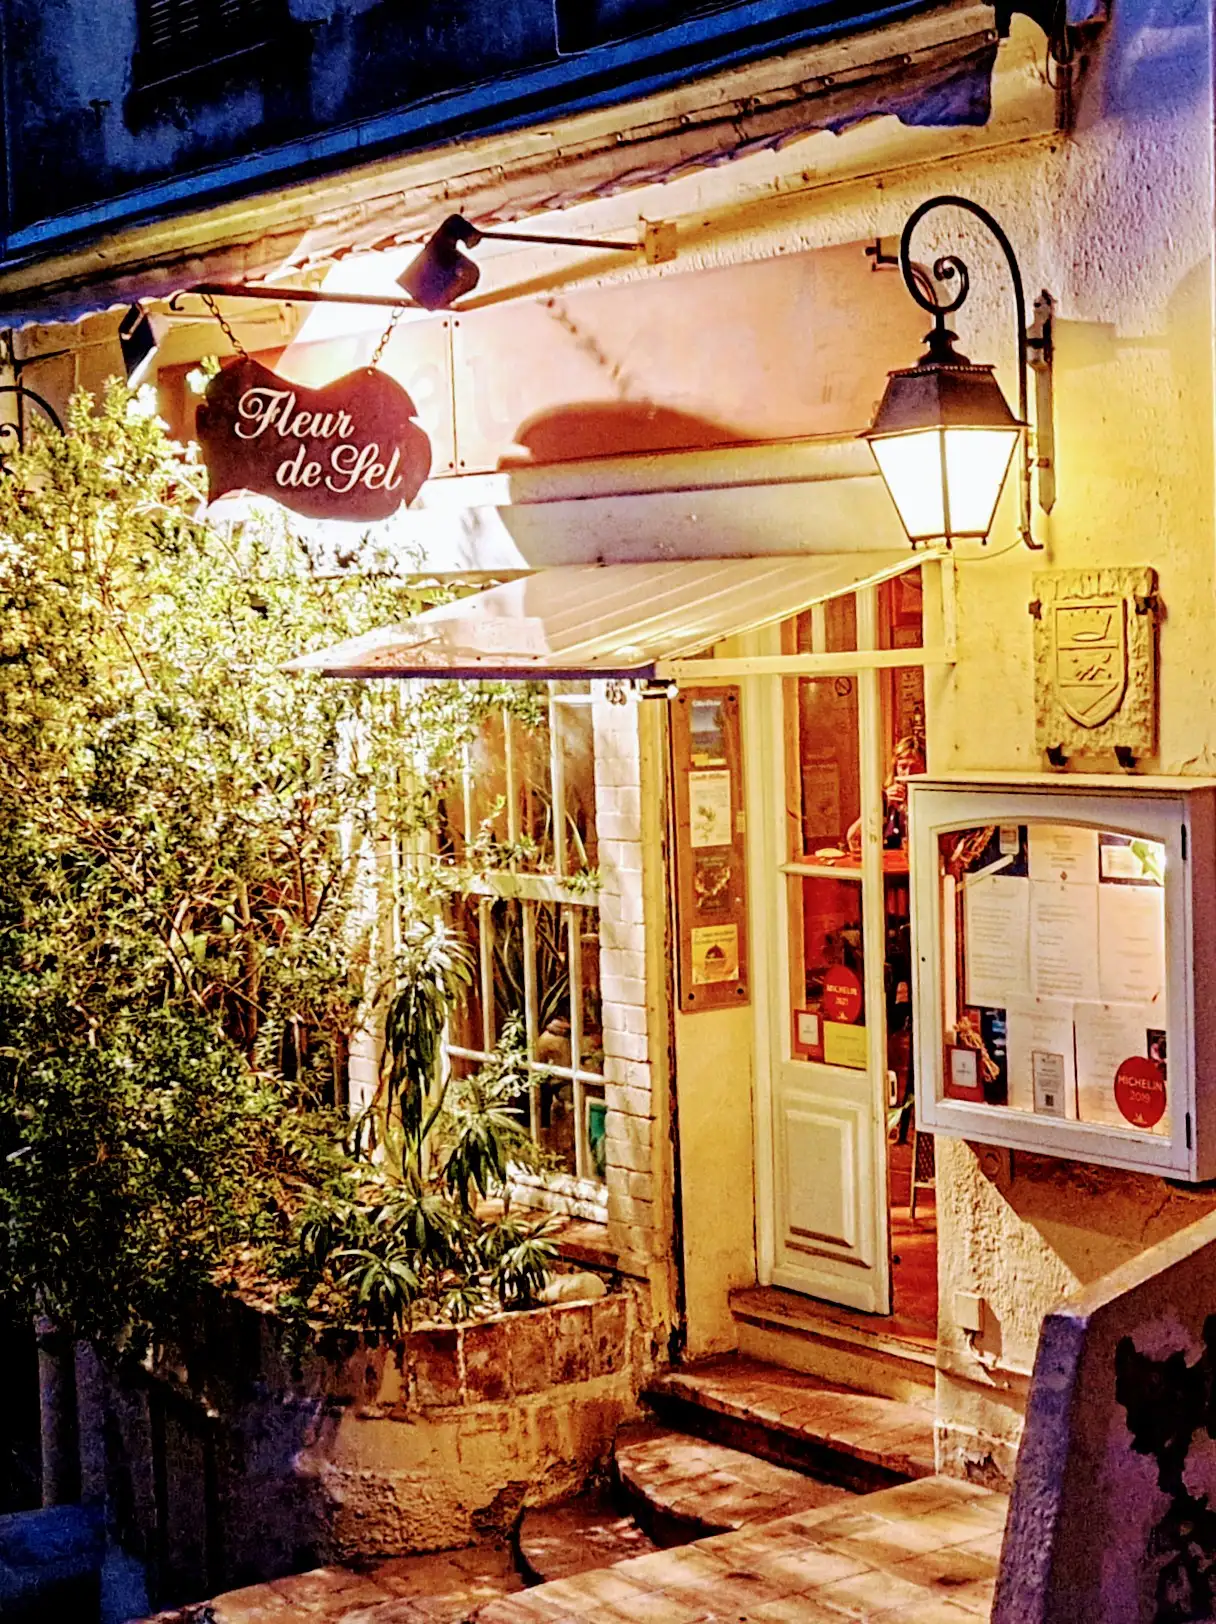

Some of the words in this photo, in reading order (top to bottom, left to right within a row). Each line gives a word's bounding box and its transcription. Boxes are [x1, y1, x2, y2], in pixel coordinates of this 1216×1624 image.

[234, 387, 355, 438] Fleur
[275, 443, 322, 487] de
[324, 442, 403, 493] Sel
[1118, 1075, 1163, 1092] MICHELIN
